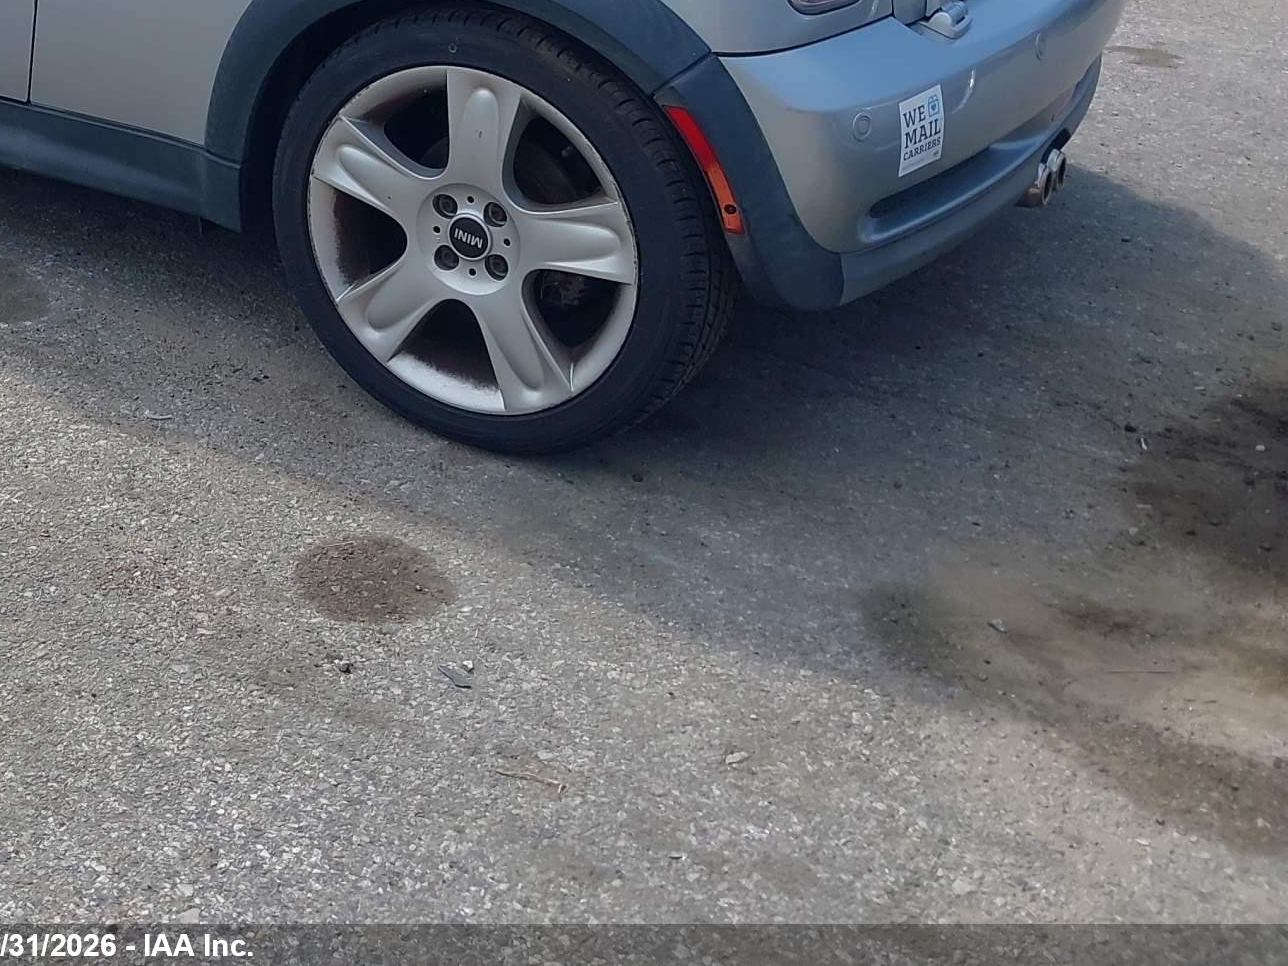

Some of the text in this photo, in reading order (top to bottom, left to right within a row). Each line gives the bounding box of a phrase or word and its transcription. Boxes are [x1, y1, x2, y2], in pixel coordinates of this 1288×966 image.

[903, 104, 927, 129] WE
[904, 118, 942, 149] MAIL
[903, 136, 942, 162] CARRIERS
[454, 227, 483, 249] MINI
